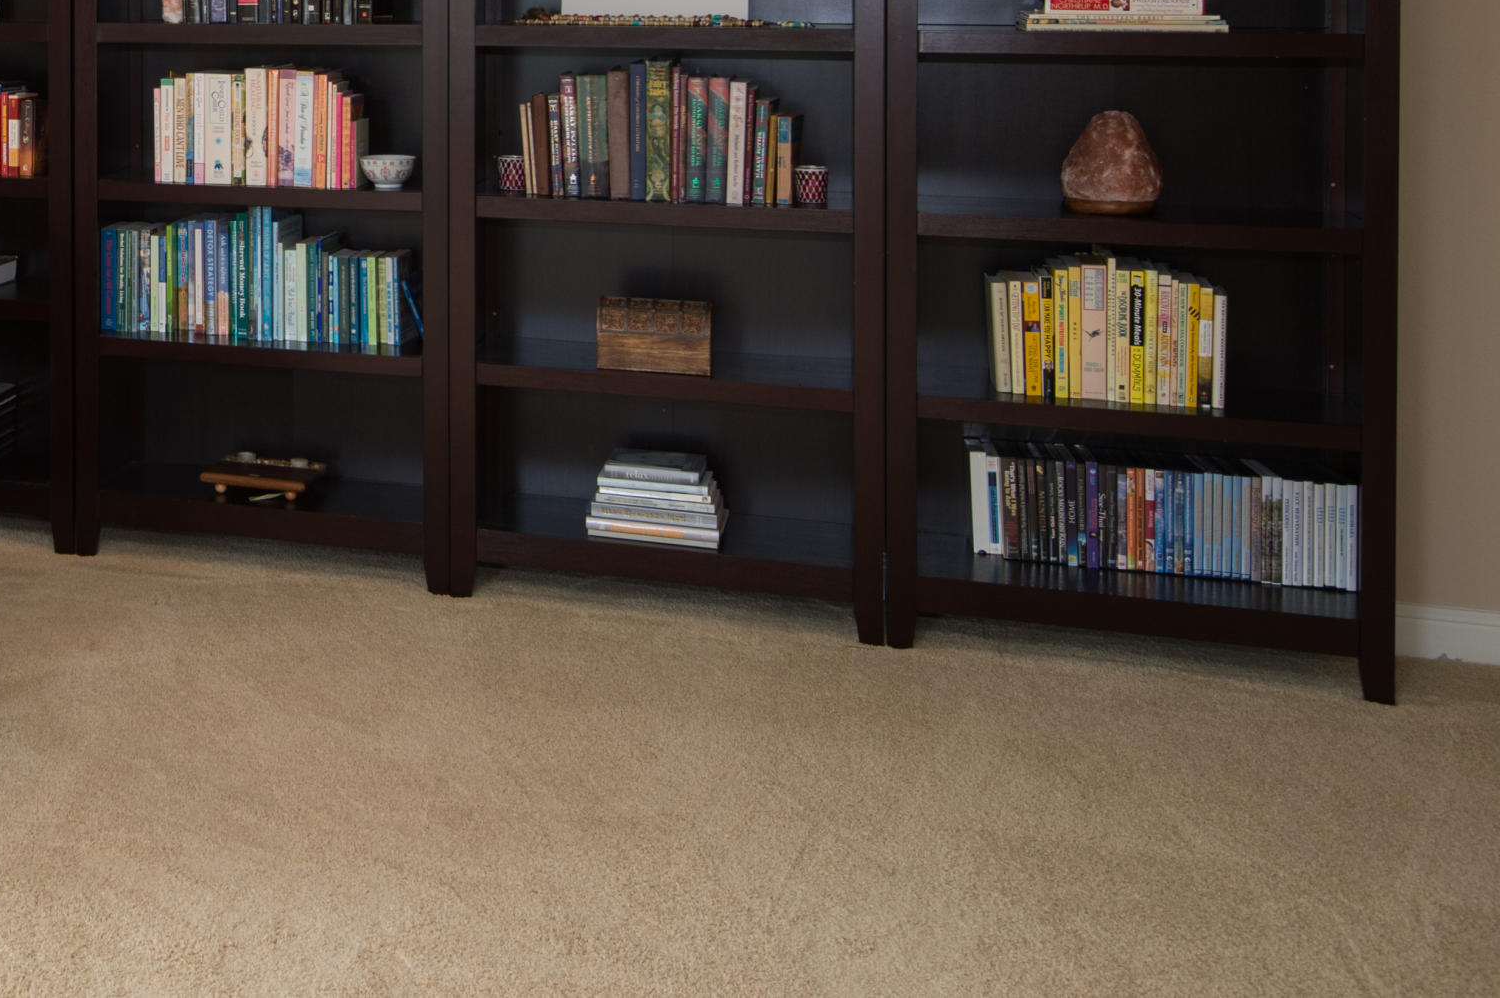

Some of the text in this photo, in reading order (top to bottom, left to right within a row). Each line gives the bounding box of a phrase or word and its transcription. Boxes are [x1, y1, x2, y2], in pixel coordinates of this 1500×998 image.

[175, 98, 185, 168] MEN WHO CAN'T LOVE
[238, 272, 246, 297] Money
[1132, 287, 1142, 392] 30-Minute Meals DUMMIES
[1067, 501, 1076, 524] HOME
